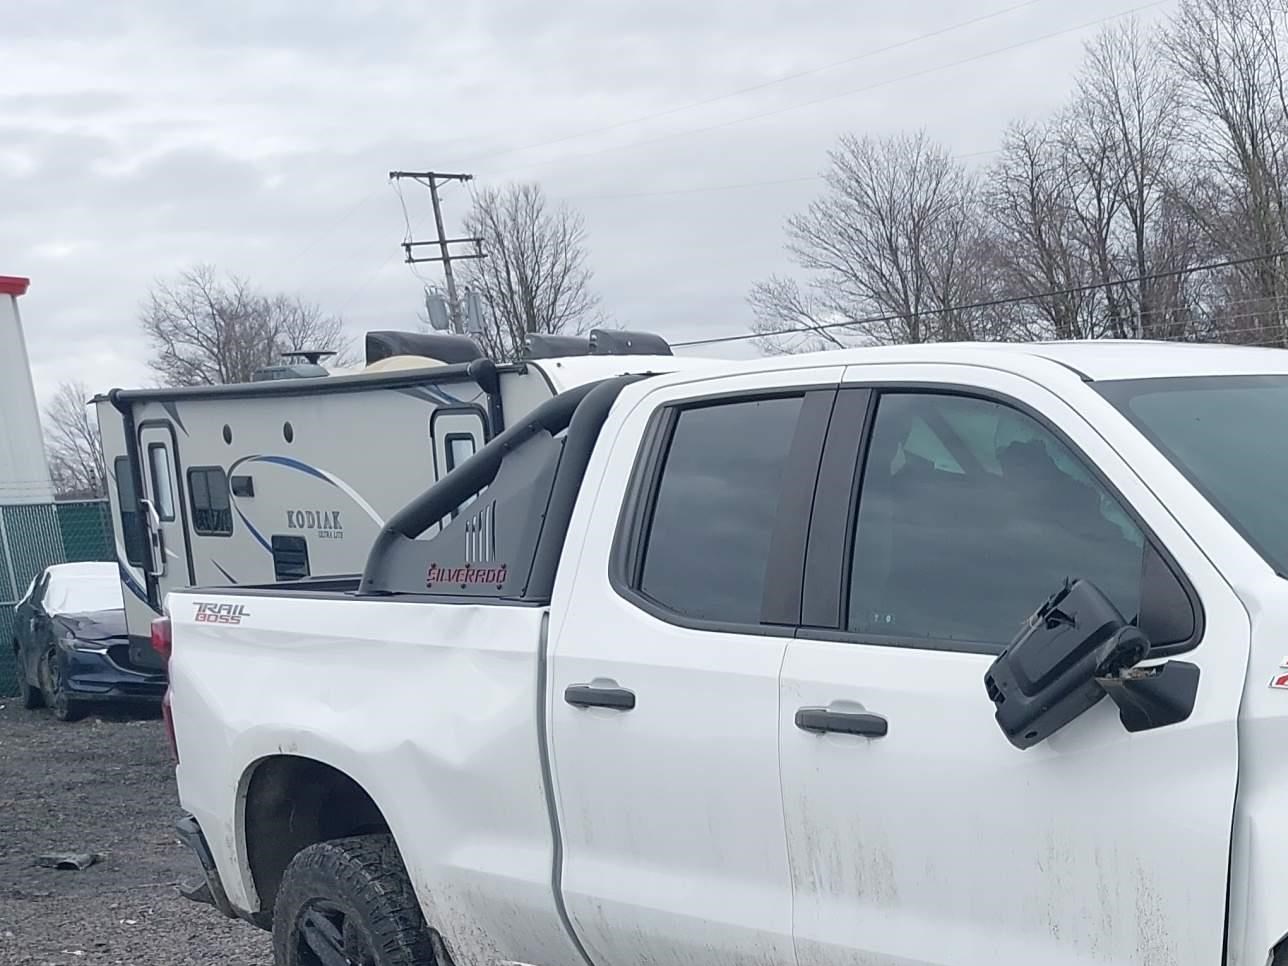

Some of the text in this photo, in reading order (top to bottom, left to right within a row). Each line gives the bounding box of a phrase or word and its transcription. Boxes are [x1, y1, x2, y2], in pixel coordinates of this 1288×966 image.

[287, 510, 343, 530] KODIAK
[426, 565, 508, 584] SILVERADO
[192, 601, 251, 617] TRAIL
[194, 612, 242, 625] BOSS
